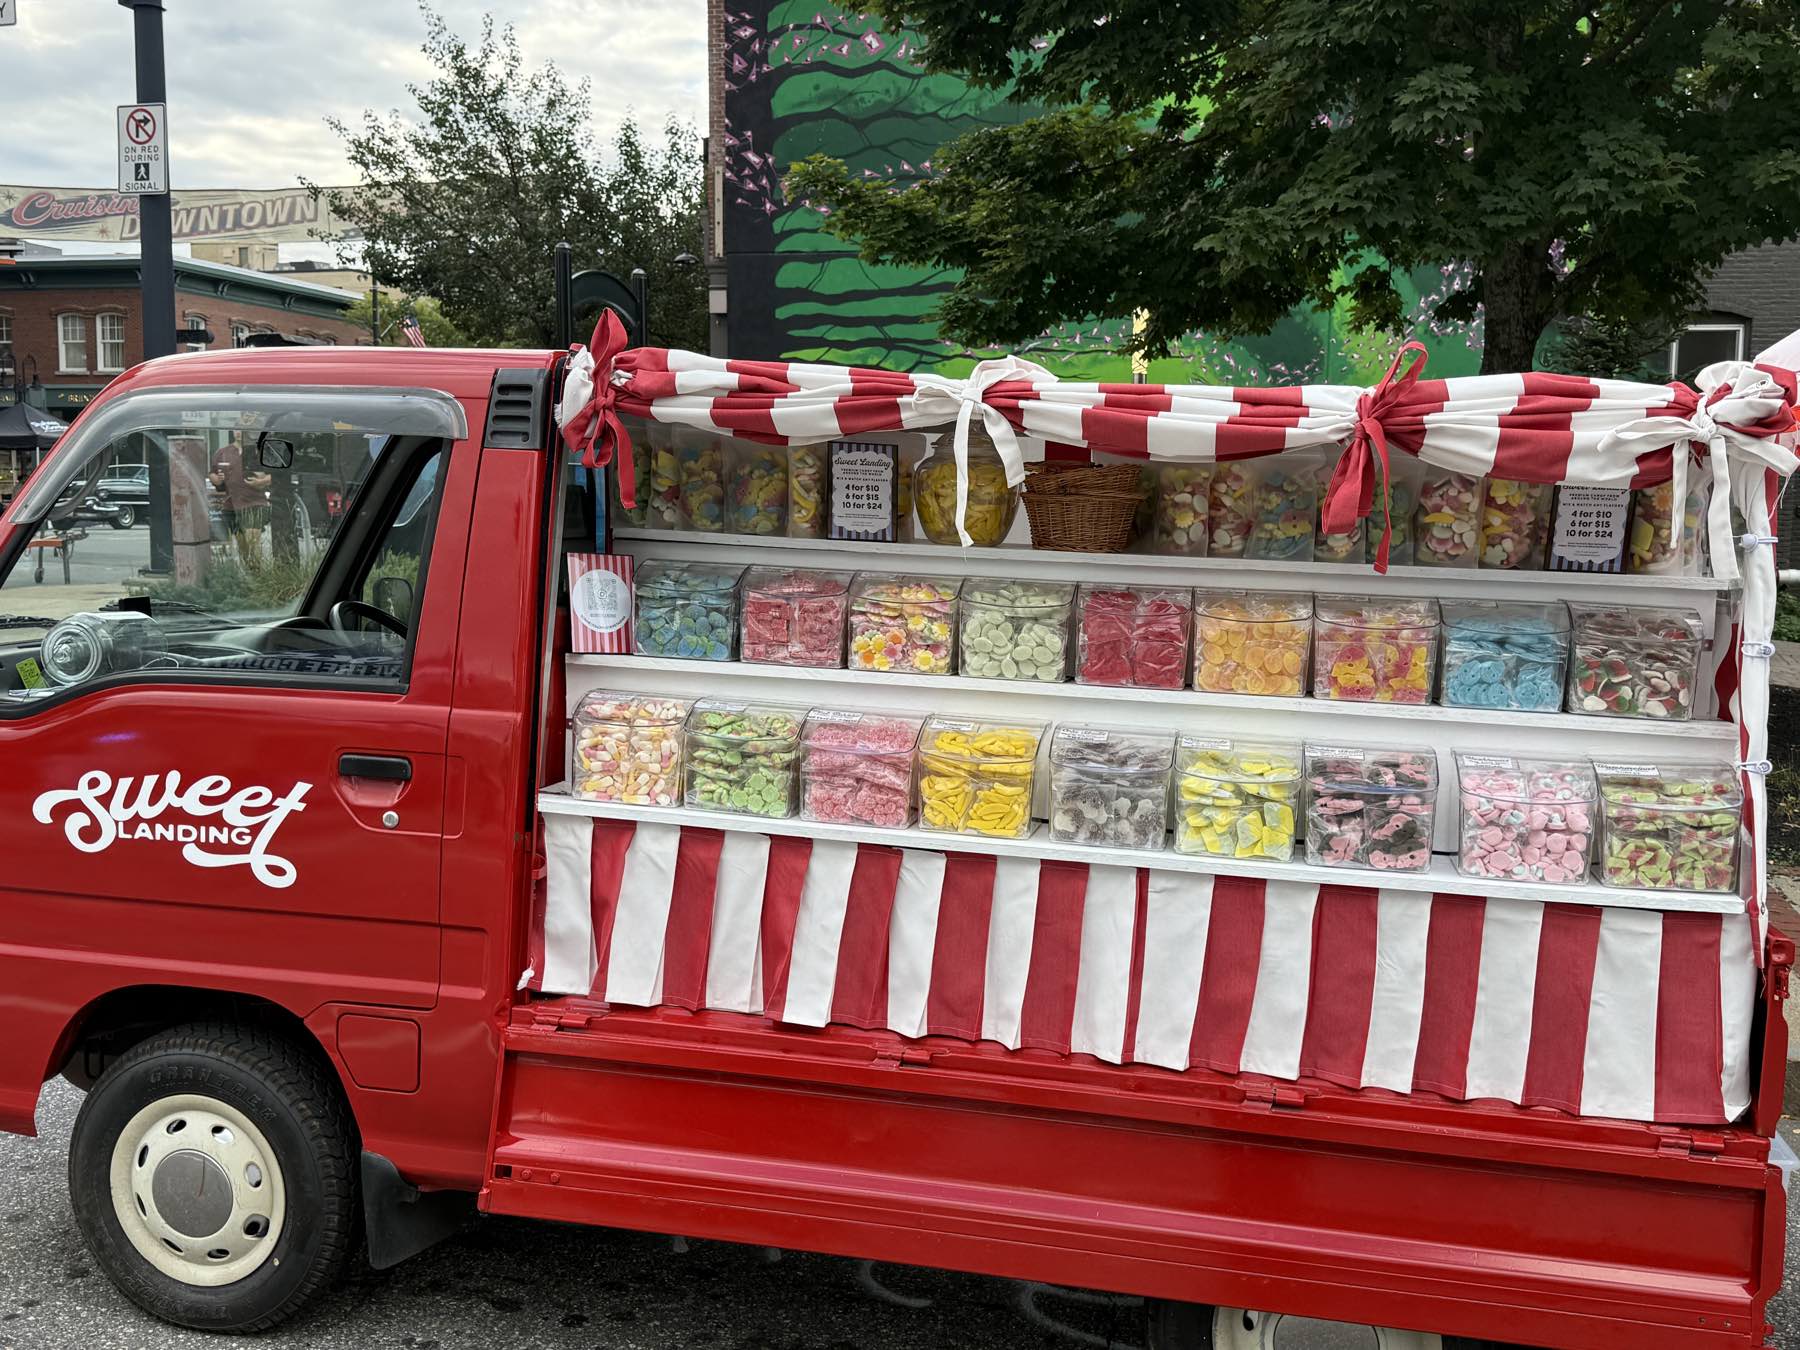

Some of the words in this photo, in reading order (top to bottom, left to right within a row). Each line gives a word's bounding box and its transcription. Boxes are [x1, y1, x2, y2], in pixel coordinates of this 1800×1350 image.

[124, 146, 137, 154] ON
[141, 145, 159, 153] RED
[124, 154, 159, 162] DURING
[125, 182, 159, 191] SIGNAL
[12, 192, 139, 226] Cruisin
[121, 197, 317, 238] DWNTOWN
[835, 457, 858, 465] Sweet
[860, 458, 891, 470] Landing
[865, 484, 880, 492] $10
[866, 493, 879, 501] $15
[867, 502, 882, 510] $24
[1596, 511, 1612, 519] $10
[1595, 520, 1610, 528] $15
[1595, 530, 1613, 538] $24
[32, 770, 313, 889] Sweet
[117, 820, 252, 846] LANDING
